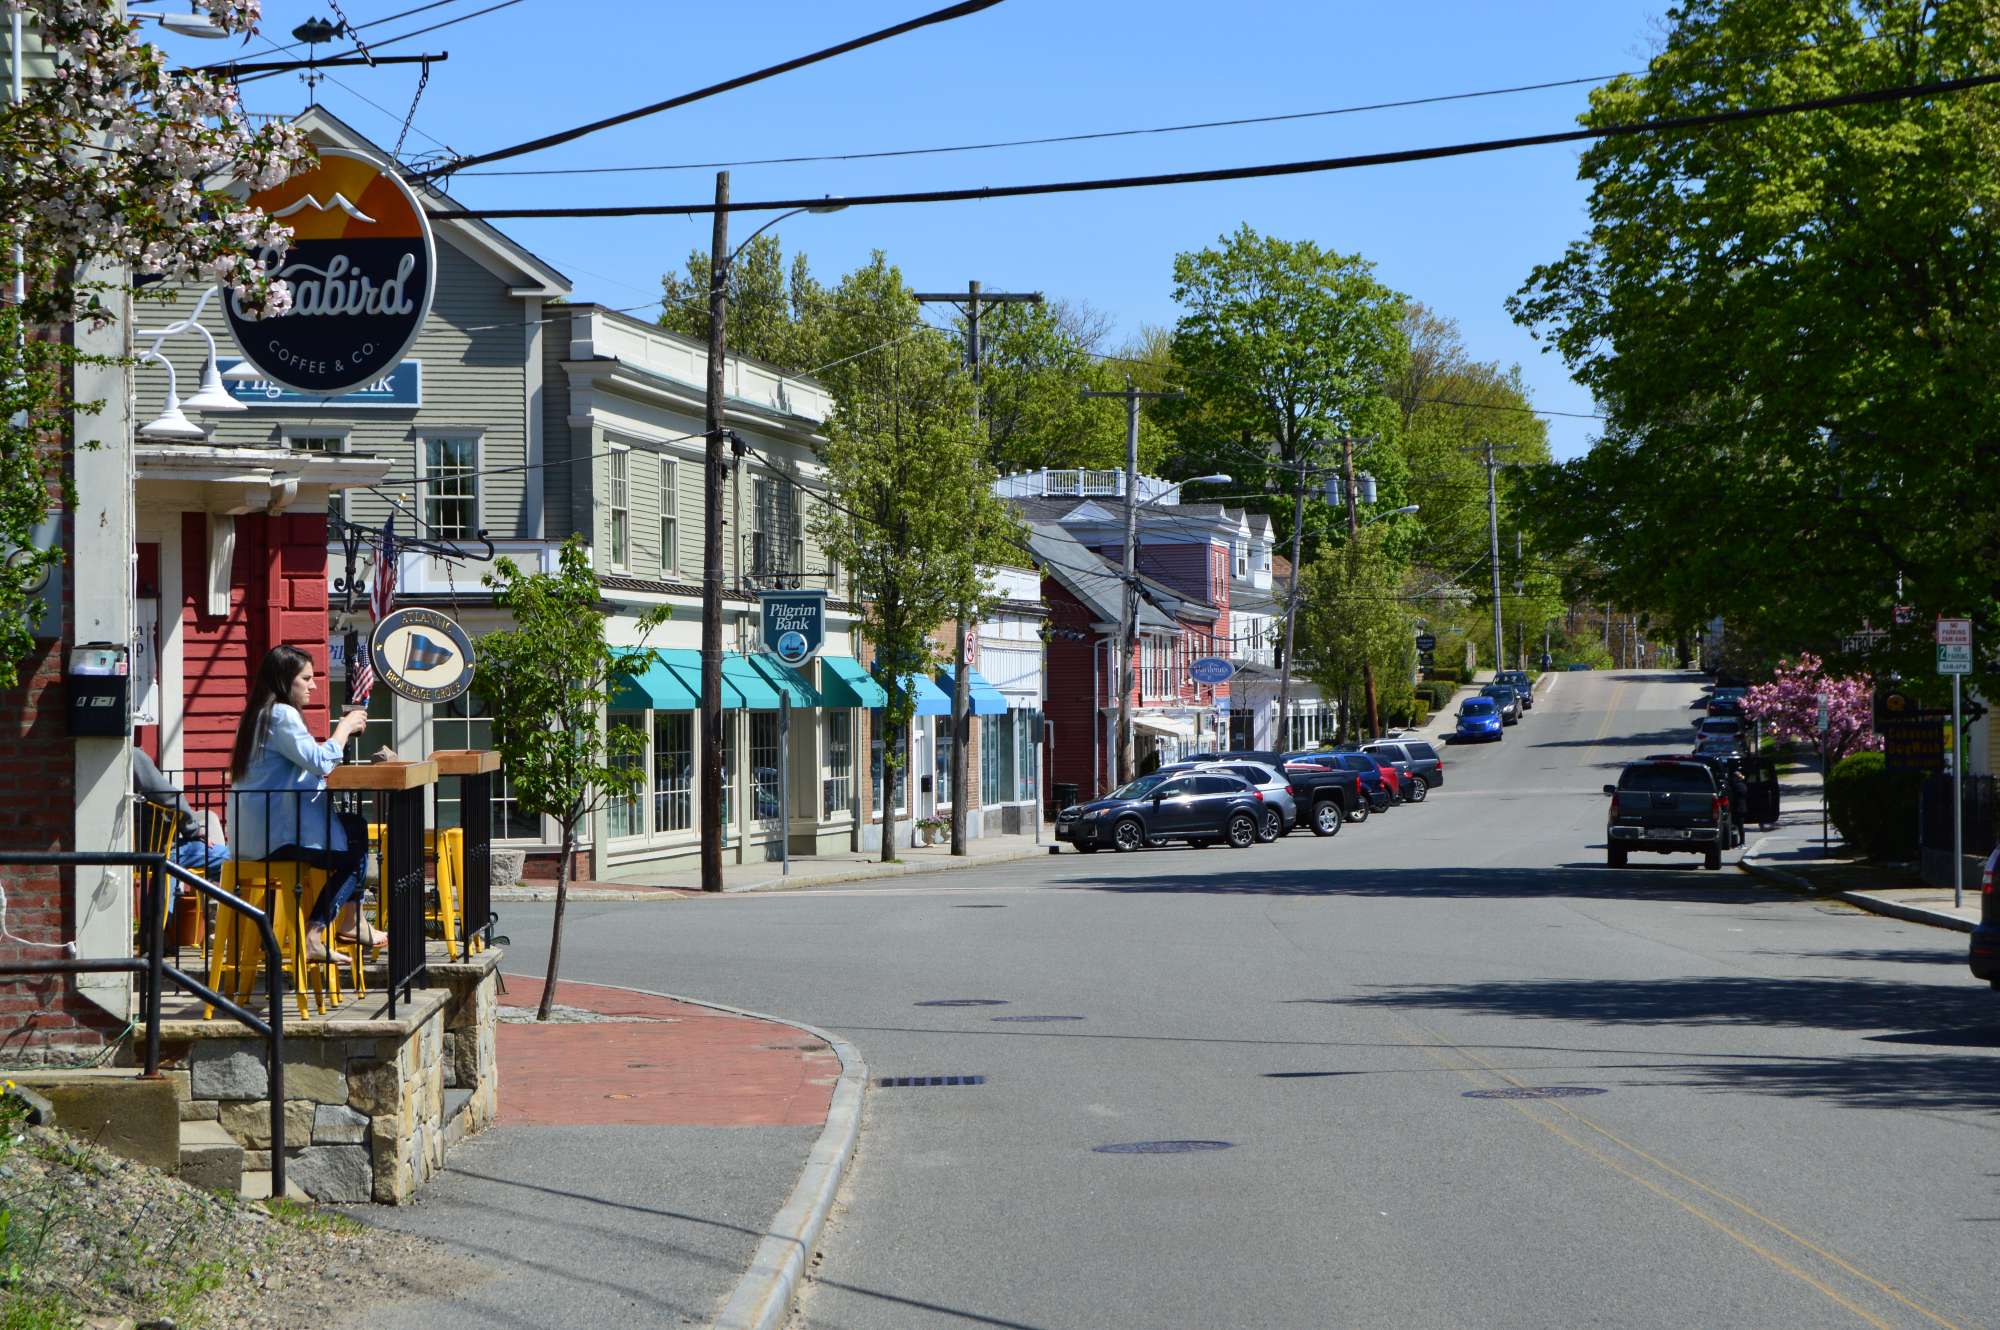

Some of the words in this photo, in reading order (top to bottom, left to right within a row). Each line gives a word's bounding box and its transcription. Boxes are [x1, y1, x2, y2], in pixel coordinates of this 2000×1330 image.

[269, 340, 326, 375] COFFEE
[335, 359, 345, 372] &
[401, 611, 453, 633] ATLANTIC
[769, 603, 816, 621] Pilgrim
[775, 616, 810, 631] Bank
[1940, 646, 1947, 660] 2
[386, 669, 431, 700] BROKERAGE
[434, 682, 461, 699] GROUP
